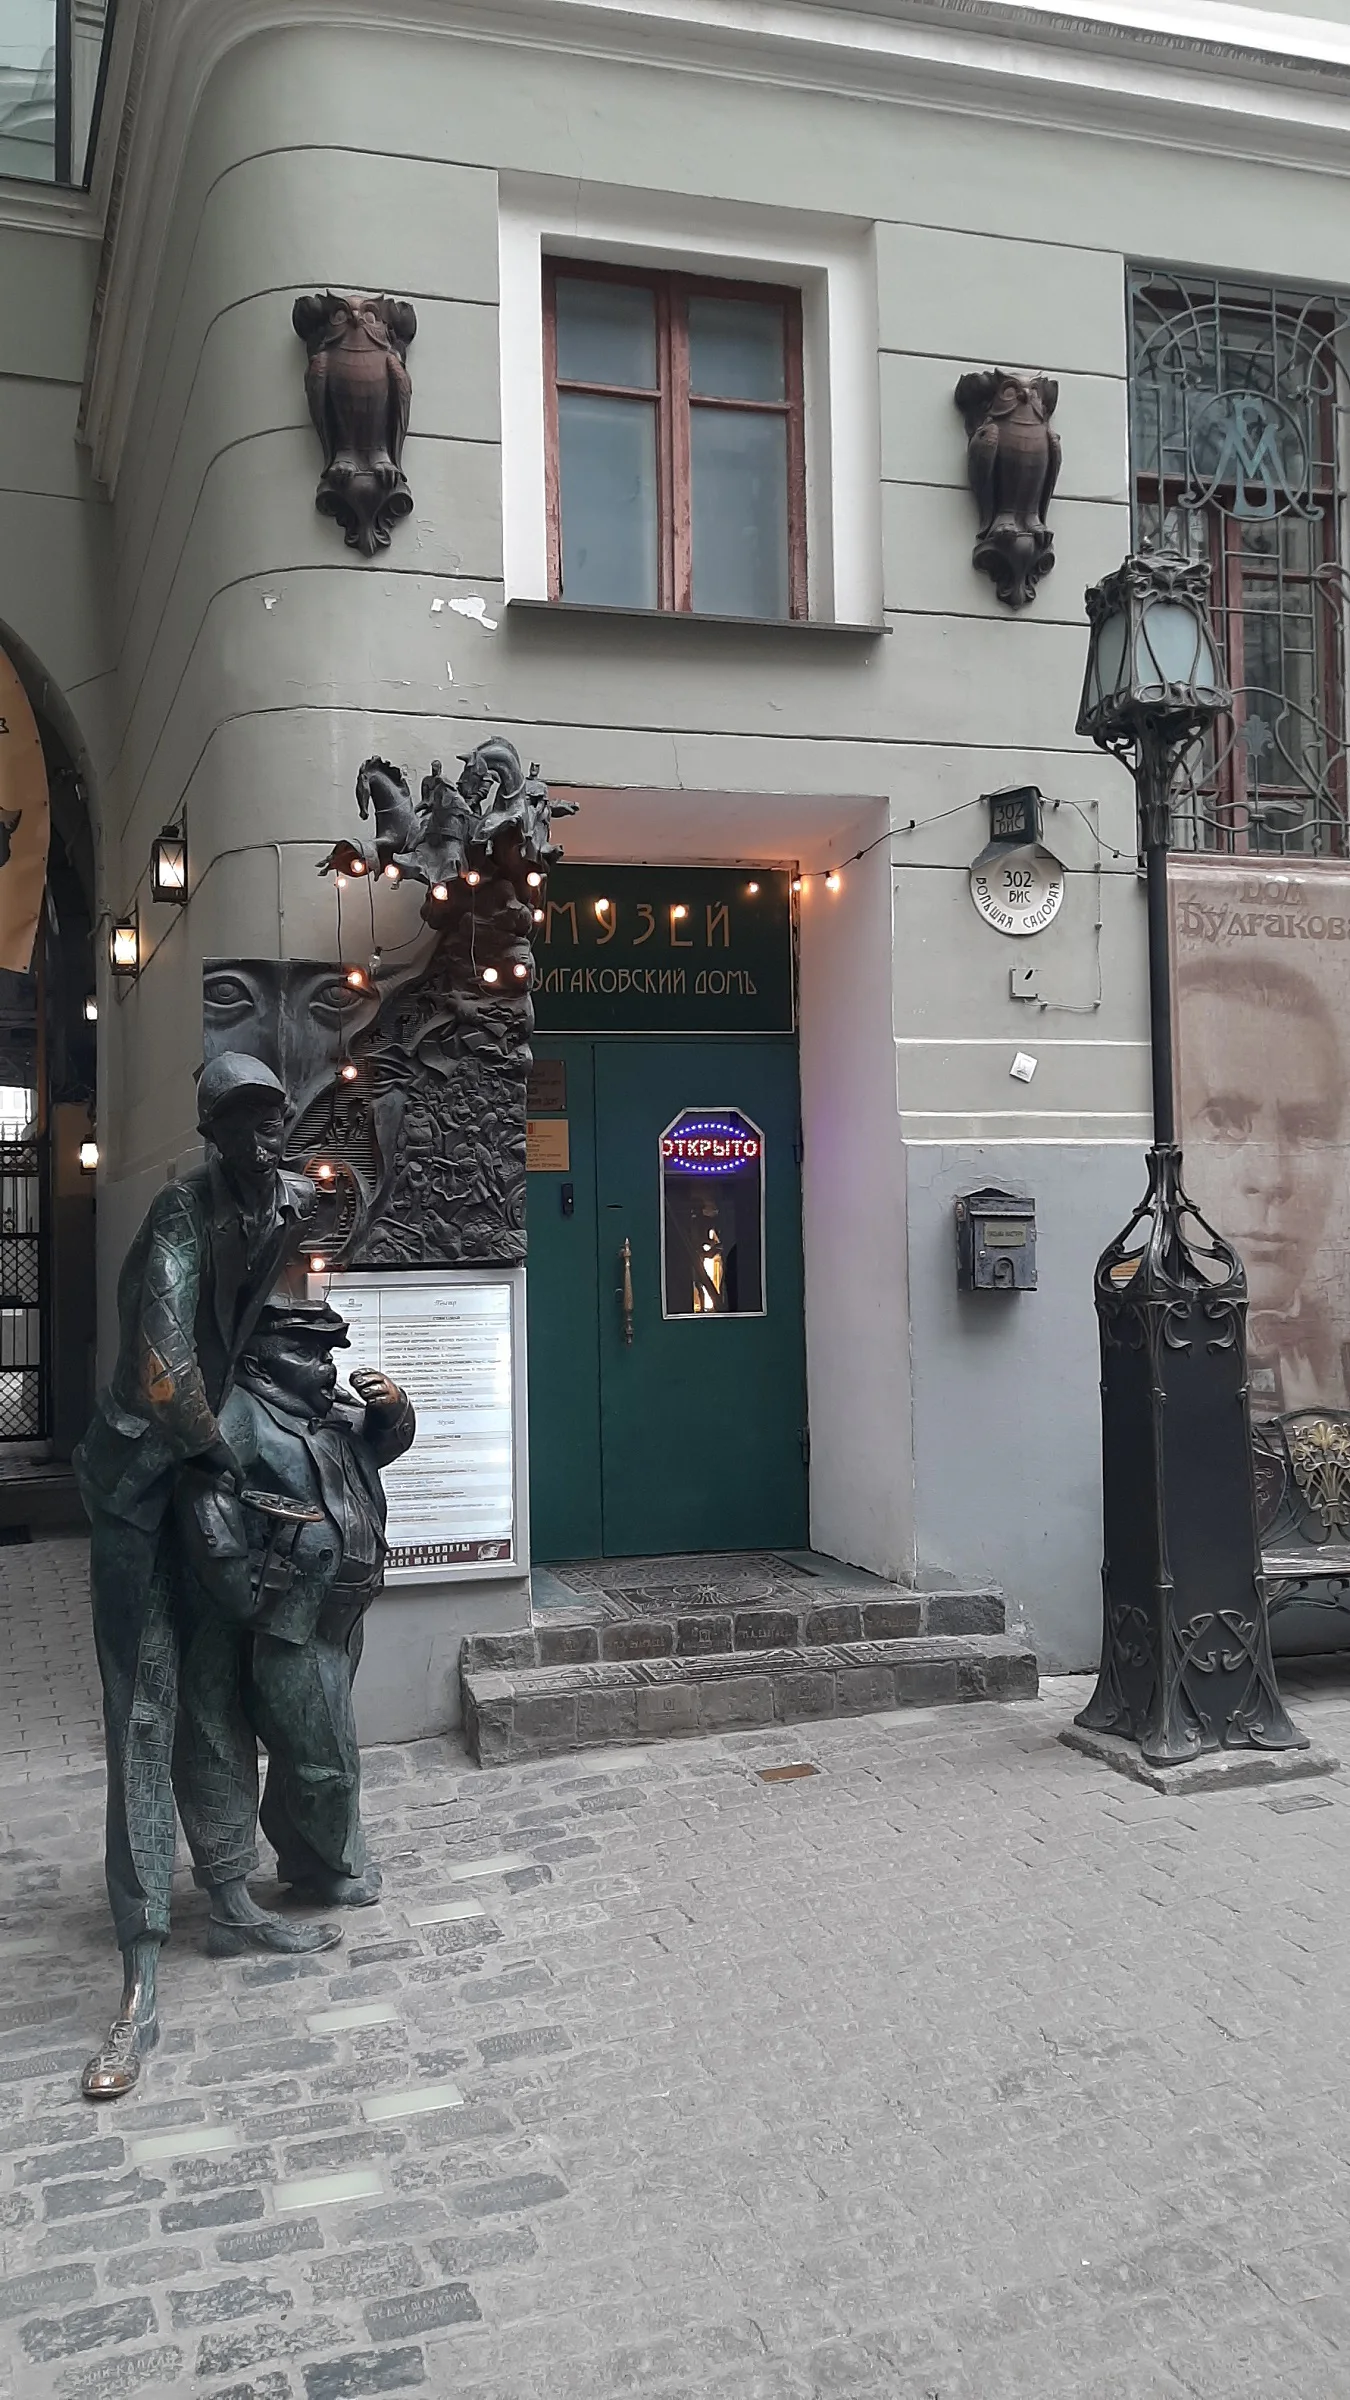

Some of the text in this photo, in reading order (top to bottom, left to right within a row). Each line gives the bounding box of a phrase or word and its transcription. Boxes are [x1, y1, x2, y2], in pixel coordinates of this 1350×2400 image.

[995, 802, 1025, 823] 302
[976, 877, 1060, 929] БОЛЬШАЯ САДОВАЯ
[1009, 891, 1031, 903] БИС
[544, 900, 730, 947] МУЗЕЙ
[1178, 900, 1350, 943] Булгаков
[532, 968, 758, 995] УЛГАКОВСКИЙ ДОМЪ
[661, 1139, 758, 1157] ОТКРЫТО
[383, 1554, 448, 1568] АССЕ МУЗЕЯ
